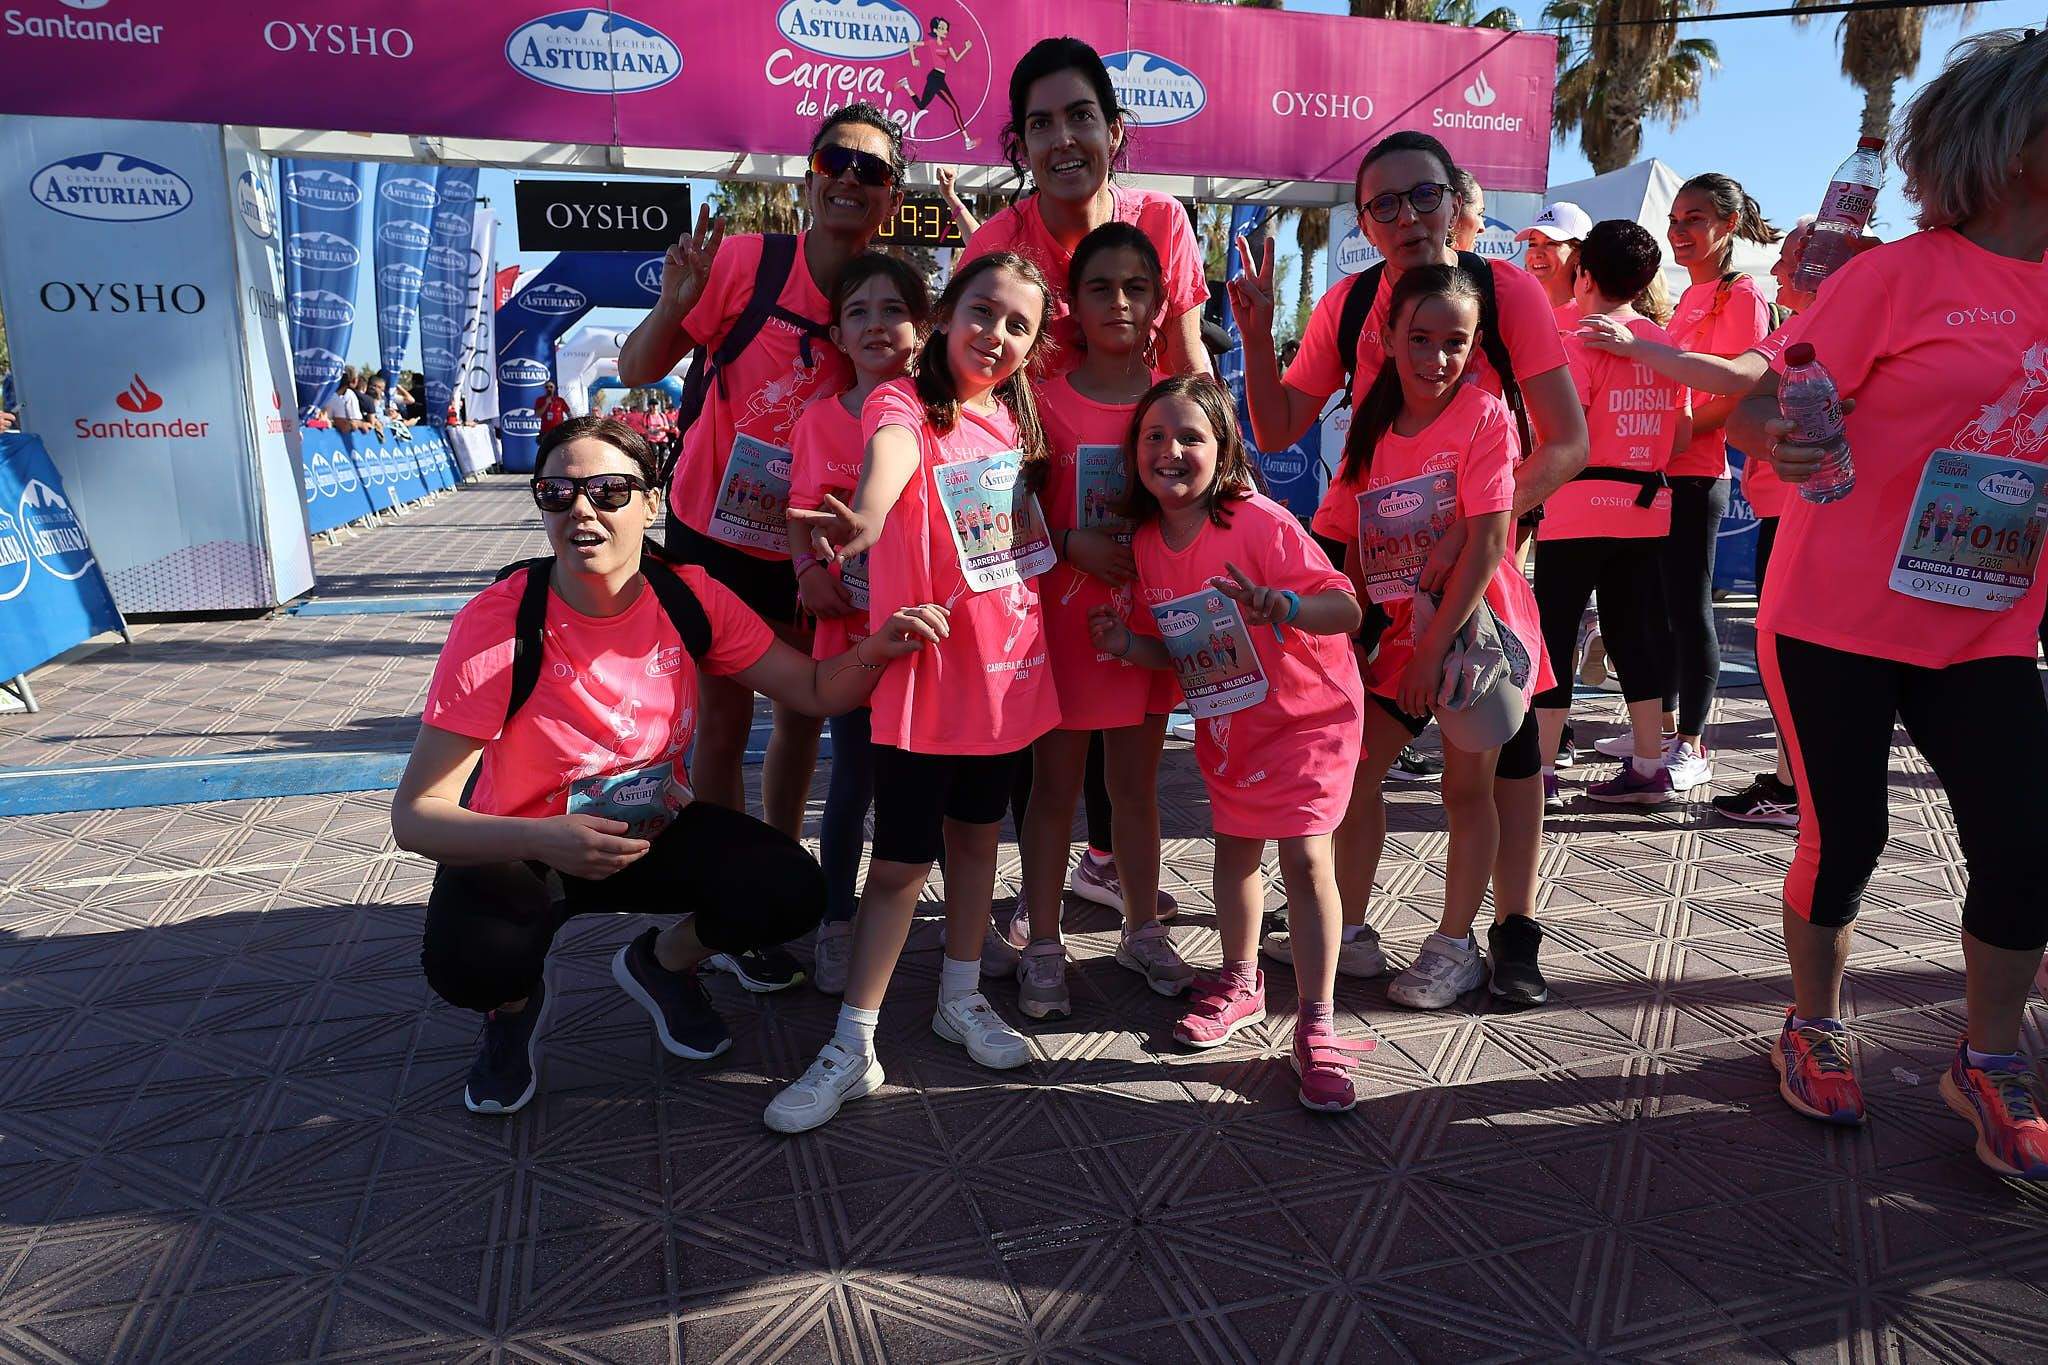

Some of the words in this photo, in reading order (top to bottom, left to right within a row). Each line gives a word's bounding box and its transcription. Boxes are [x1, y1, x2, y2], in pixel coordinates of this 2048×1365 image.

[4, 10, 164, 44] Santander
[788, 8, 911, 44] ASTURIANA
[263, 20, 414, 58] OYSHO
[520, 35, 670, 74] ASTURIANA
[765, 48, 886, 94] Carrera
[795, 91, 818, 117] de
[1271, 90, 1374, 121] OYSHO
[1432, 108, 1523, 132] Santander
[44, 175, 183, 206] ASTURIANA
[1839, 194, 1869, 207] ZERO
[546, 203, 668, 231] OYSHO
[40, 281, 206, 314] OYSHO
[523, 294, 581, 308] ASTURIANA
[501, 369, 548, 381] ASTURIANA
[1632, 363, 1654, 385] TU
[1608, 387, 1676, 413] DORSAL
[75, 418, 209, 439] Santander
[1615, 413, 1663, 437] SUMA
[945, 474, 969, 486] SUMA
[1937, 465, 1969, 478] SUMA
[1380, 498, 1421, 514] ASTURIANA
[1590, 495, 1633, 508] OYSHO
[720, 512, 750, 526] CARRERA
[750, 521, 759, 529] DE
[760, 523, 769, 531] LA
[723, 526, 760, 542] OYSHO
[1386, 529, 1431, 556] 016
[1970, 524, 2020, 554] 016
[967, 556, 1000, 569] CARRERA
[1000, 552, 1010, 560] DE
[1907, 559, 1953, 575] CARRERA
[1955, 567, 1970, 577] DE
[1971, 570, 1983, 579] LA
[1984, 571, 2006, 583] MUJER
[1978, 556, 2003, 570] 2836
[1367, 571, 1392, 583] CARRERA
[1400, 568, 1410, 577] LA
[1375, 583, 1408, 597] OYSHO
[1911, 577, 1971, 597] OYSHO
[1160, 617, 1198, 633] ASTURIANA
[986, 660, 1016, 673] CARRERA
[1016, 659, 1025, 669] DE
[1025, 658, 1033, 667] LA
[1189, 689, 1198, 697] LA
[1197, 685, 1218, 696] MUJER
[1222, 674, 1256, 688] VALENCIA
[1217, 690, 1256, 707] Santander
